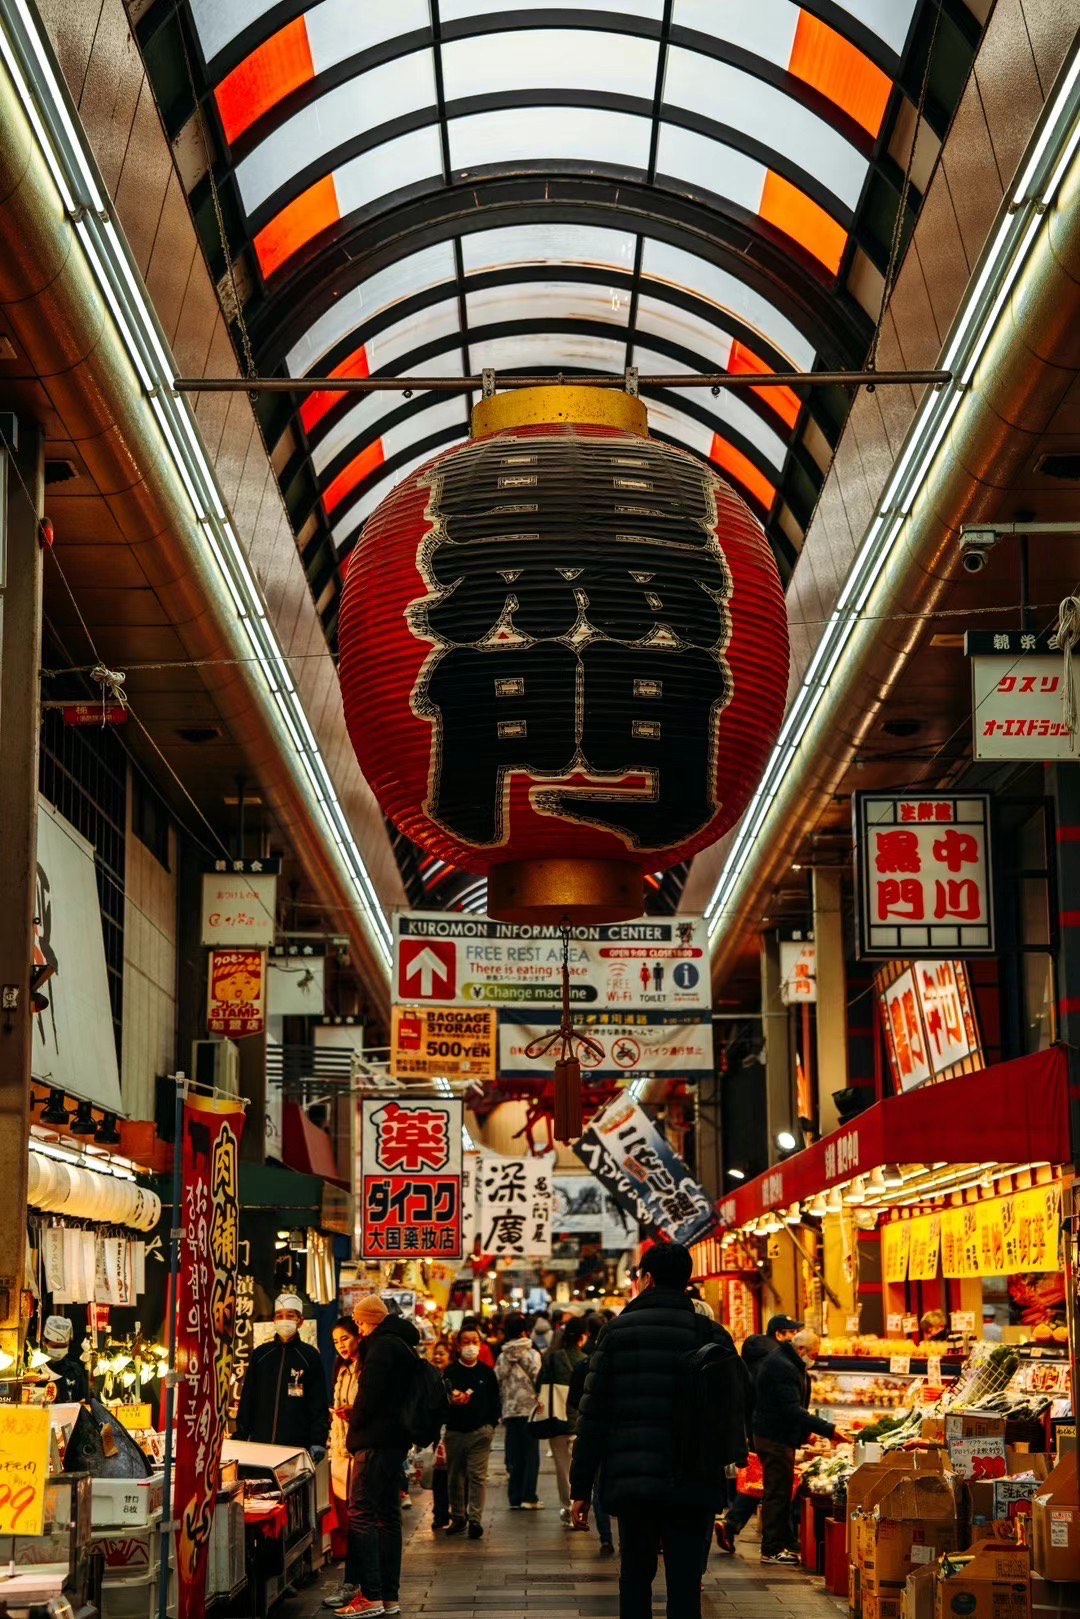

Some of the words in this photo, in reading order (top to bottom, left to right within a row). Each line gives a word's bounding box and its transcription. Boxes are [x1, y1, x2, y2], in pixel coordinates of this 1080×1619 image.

[996, 676, 1060, 693] クスリ
[875, 830, 925, 921] 黒門
[932, 829, 981, 920] 中川
[408, 922, 488, 936] KUROMON
[607, 926, 662, 940] CENTER
[466, 945, 503, 961] FREE
[507, 946, 541, 961] REST
[546, 947, 590, 962] AREA
[470, 963, 502, 974] There
[504, 964, 513, 974] is
[516, 964, 552, 977] eating
[555, 966, 588, 977] sace
[606, 979, 630, 990] FREE
[486, 985, 532, 1001] Change
[606, 992, 632, 1002] Wi-Fi
[640, 994, 666, 1003] TOILET
[211, 1008, 260, 1018] STAMP
[426, 1012, 491, 1023] BAGGAGE
[561, 1014, 648, 1025] 行者専用通路
[427, 1023, 491, 1034] STORAGE
[373, 1102, 449, 1172] 薬
[368, 1180, 457, 1224] ダイコク
[185, 1184, 202, 1343] 정육점의
[125, 1495, 139, 1503] 甘口
